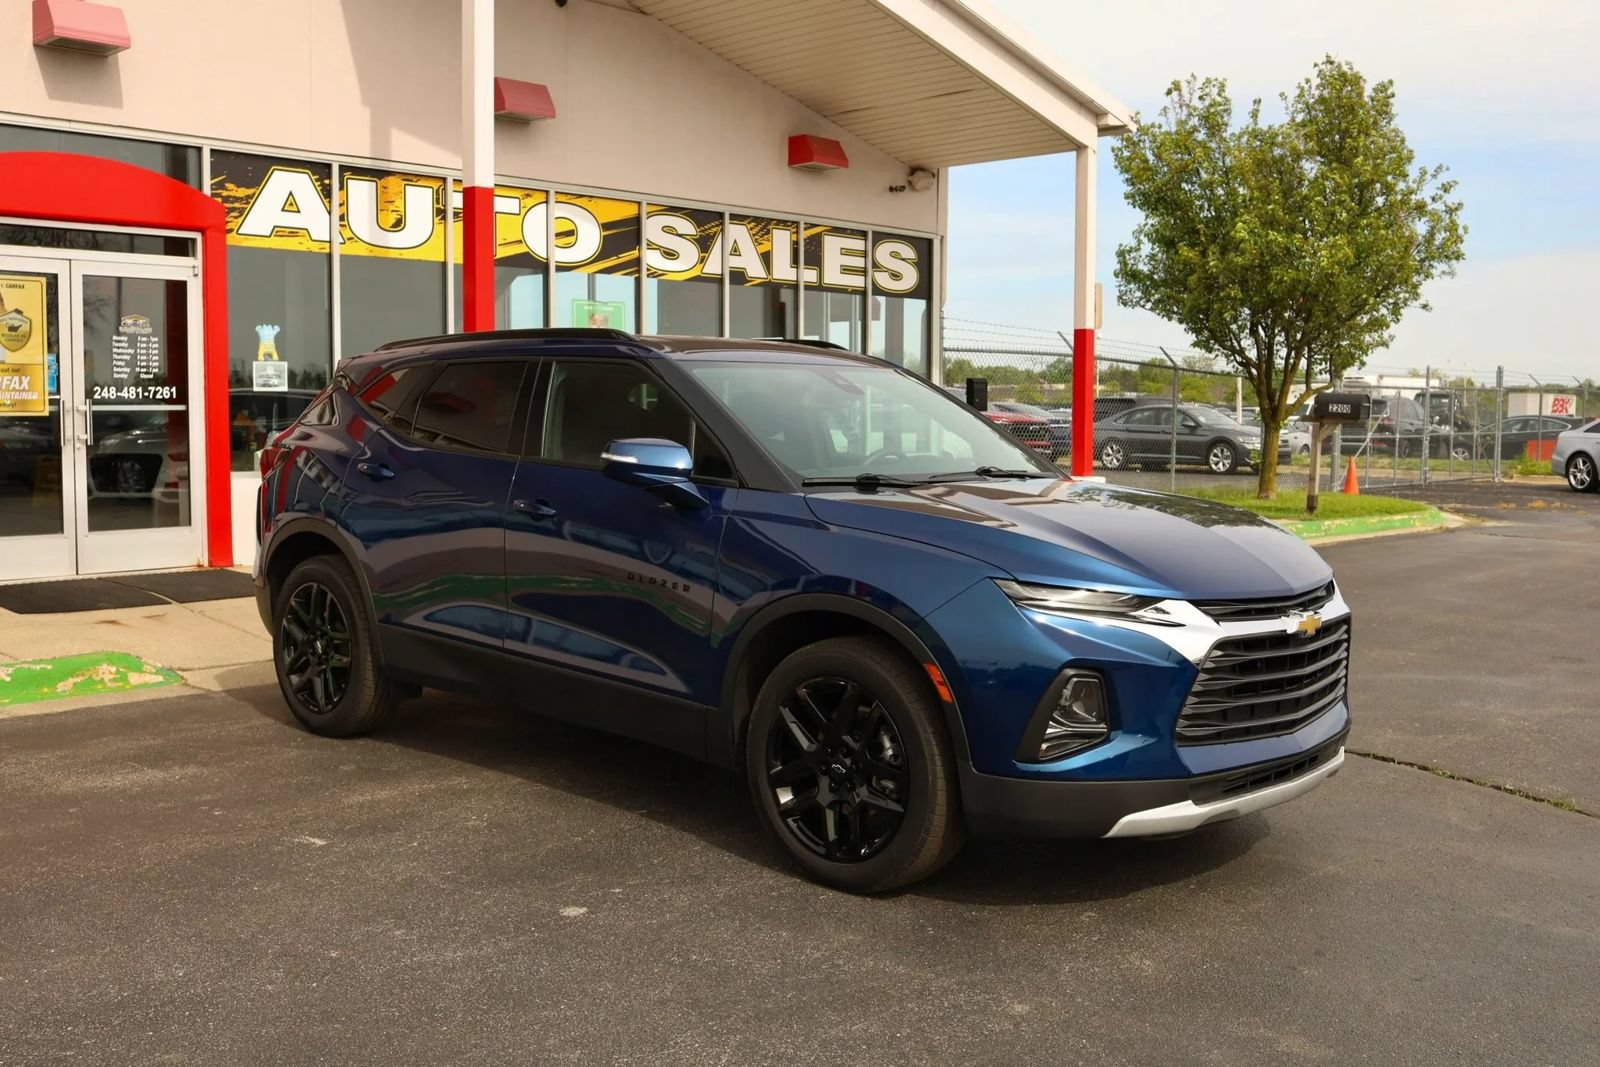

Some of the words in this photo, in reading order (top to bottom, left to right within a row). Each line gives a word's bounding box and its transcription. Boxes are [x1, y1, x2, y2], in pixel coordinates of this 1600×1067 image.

[645, 212, 920, 293] SALES
[93, 386, 176, 399] 248-481-7261
[1329, 404, 1351, 413] 2200
